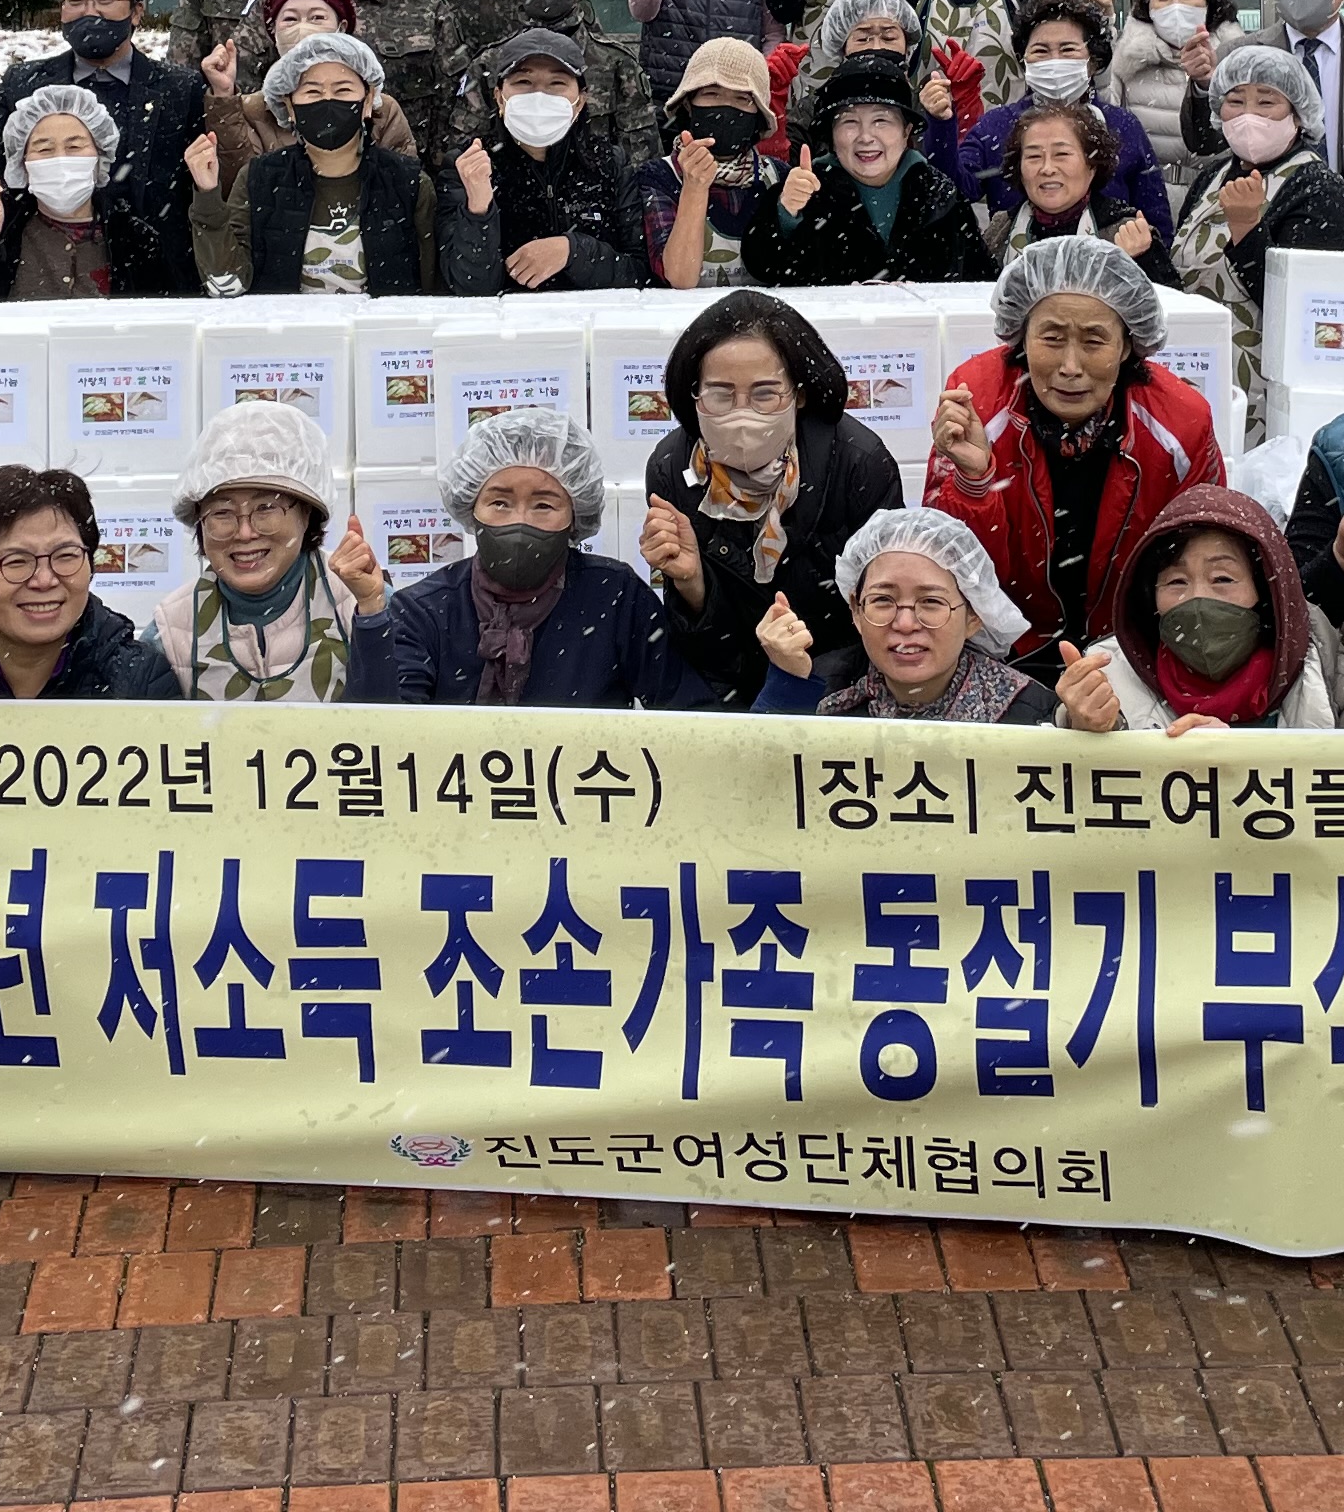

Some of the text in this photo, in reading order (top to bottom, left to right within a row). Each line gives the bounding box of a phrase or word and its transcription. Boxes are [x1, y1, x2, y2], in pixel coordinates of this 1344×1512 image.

[78, 376, 107, 387] 사랑의
[231, 372, 260, 383] 사랑의
[623, 374, 654, 384] 사랑의
[462, 389, 493, 401] 사랑의
[247, 743, 662, 826] 12월14일(수)
[94, 850, 382, 1084] 저소득
[420, 857, 815, 1102] 조손가족
[852, 869, 1159, 1108] 동절기
[484, 1132, 1112, 1202] 진도군여성단체협의회
